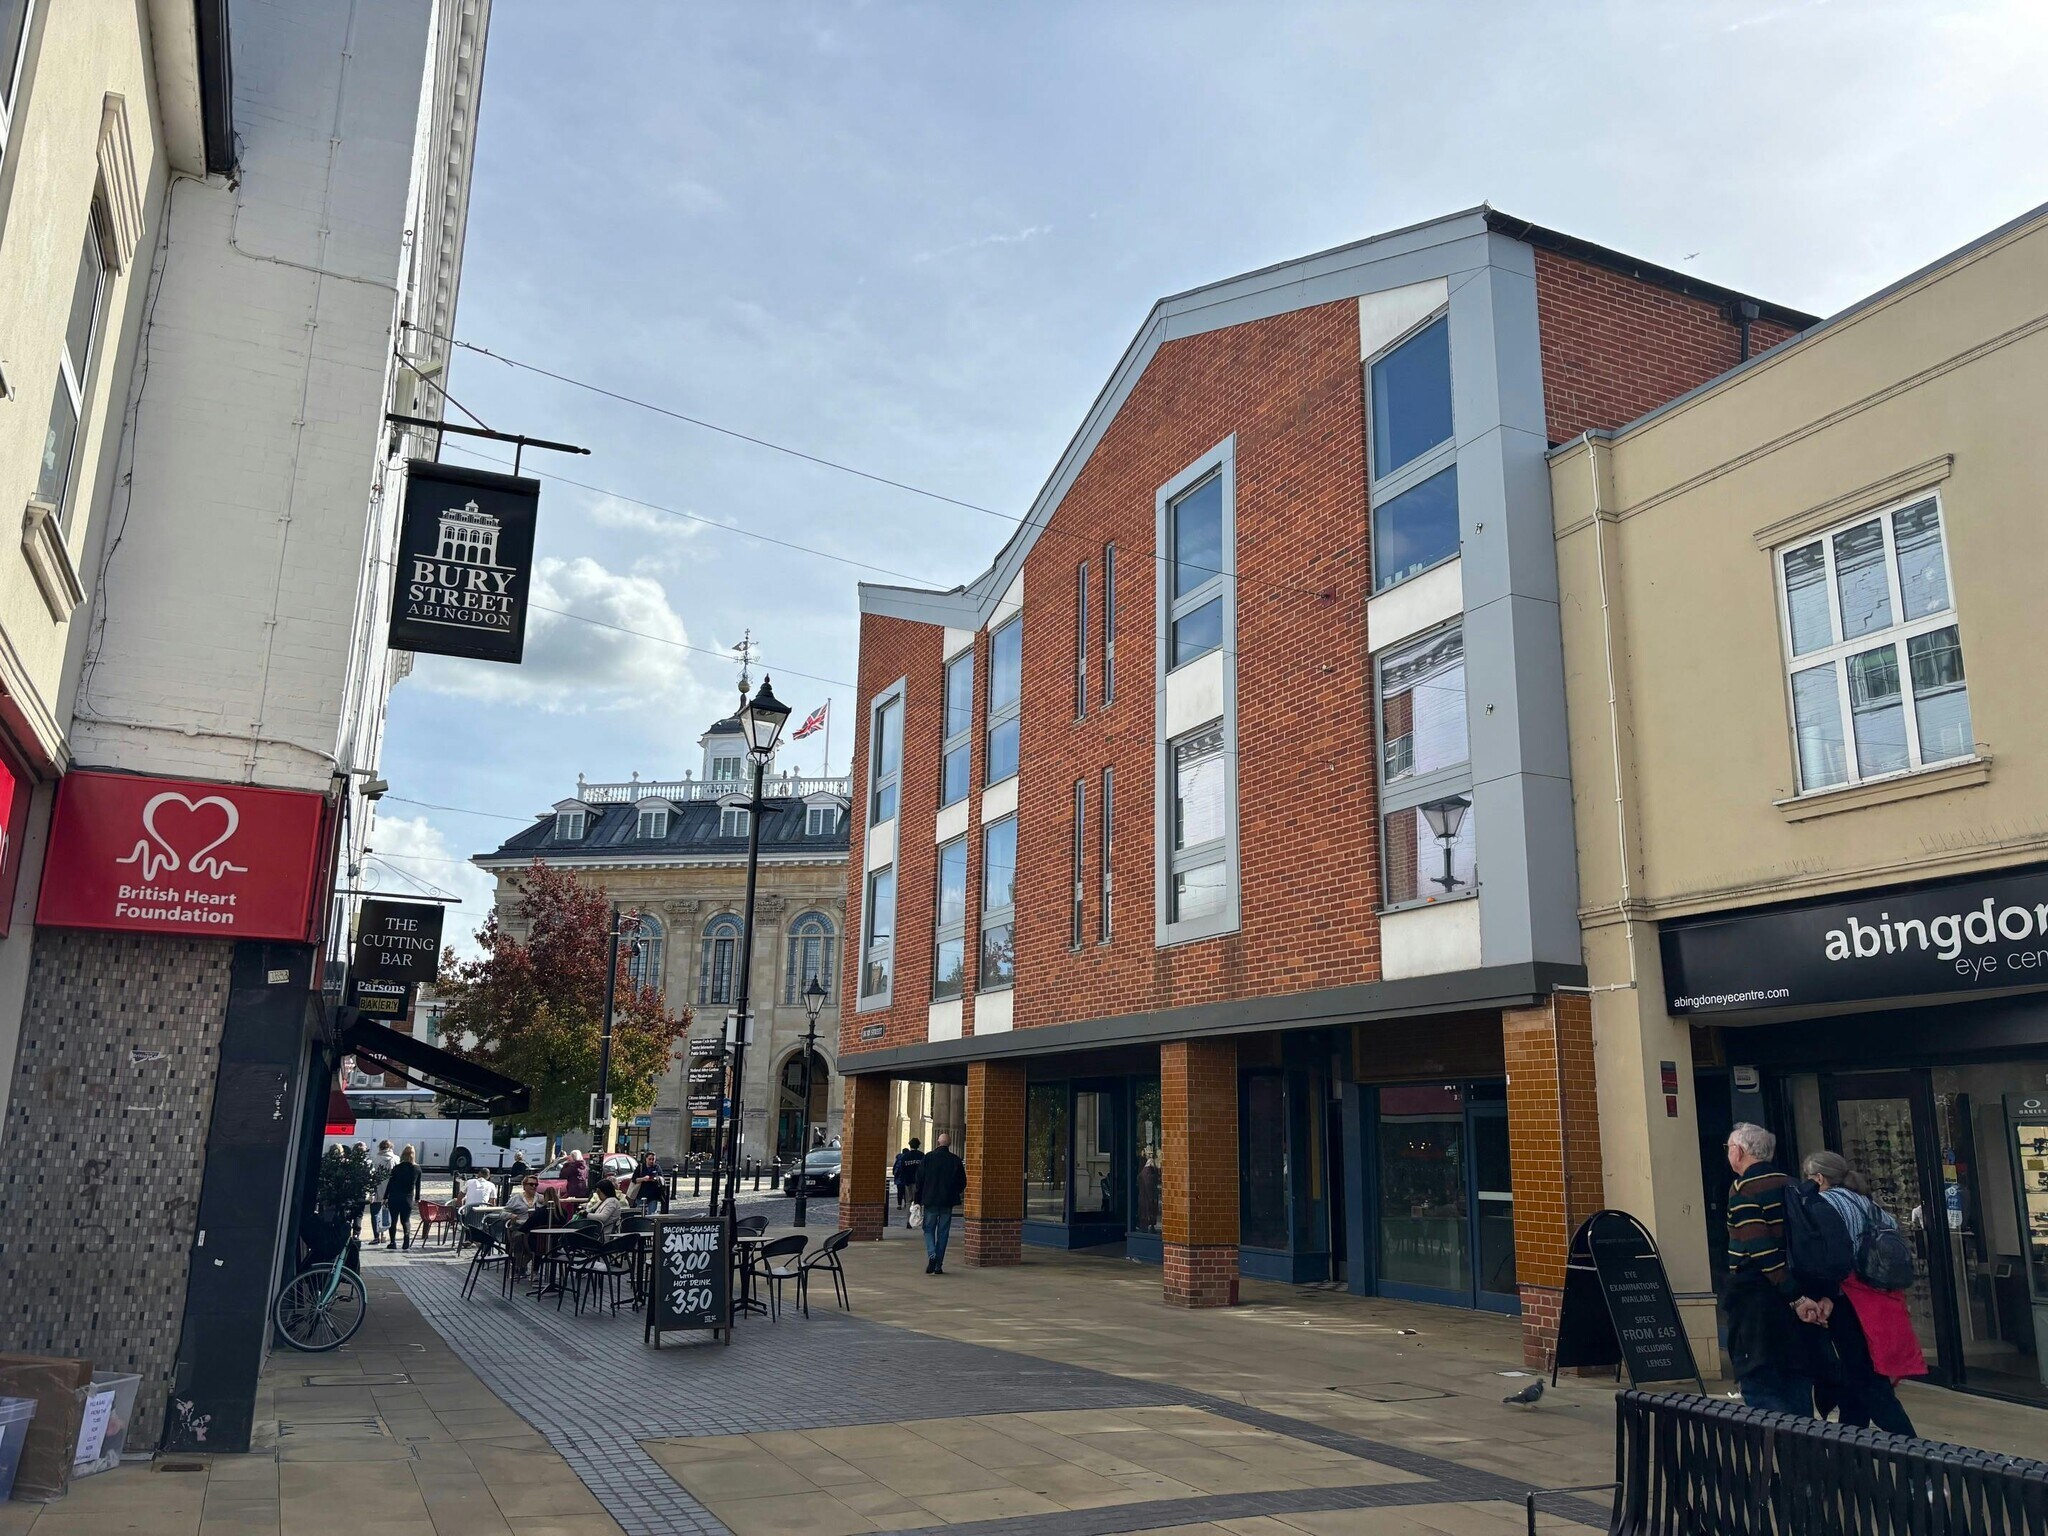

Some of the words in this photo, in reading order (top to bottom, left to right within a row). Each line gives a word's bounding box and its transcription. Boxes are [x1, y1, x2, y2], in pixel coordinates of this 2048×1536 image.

[410, 560, 516, 594] BURY
[408, 584, 514, 612] STREET
[408, 603, 512, 626] ABINGDON
[118, 885, 180, 902] British
[184, 890, 237, 906] Heart
[115, 902, 234, 924] Foundation
[385, 917, 418, 932] THE
[362, 934, 434, 950] CUTTING
[380, 952, 413, 966] BAR
[1955, 956, 1997, 981] eye
[357, 980, 406, 993] Parsons
[360, 998, 399, 1012] BAKERY
[1674, 988, 1790, 1008] abingdoneyecentre.com
[662, 1233, 720, 1253] SARNIE
[663, 1251, 710, 1275] £3.00
[1624, 1271, 1638, 1279] EYE
[1610, 1282, 1660, 1292] EXAMINATIONS
[664, 1288, 713, 1314] £3.50
[1622, 1294, 1657, 1304] AVAILABLE
[1634, 1316, 1656, 1324] SPECS
[1622, 1328, 1654, 1340] FROM
[1658, 1326, 1676, 1338] £45
[1636, 1344, 1673, 1354] INCLUDING
[1646, 1358, 1672, 1367] LENSES
